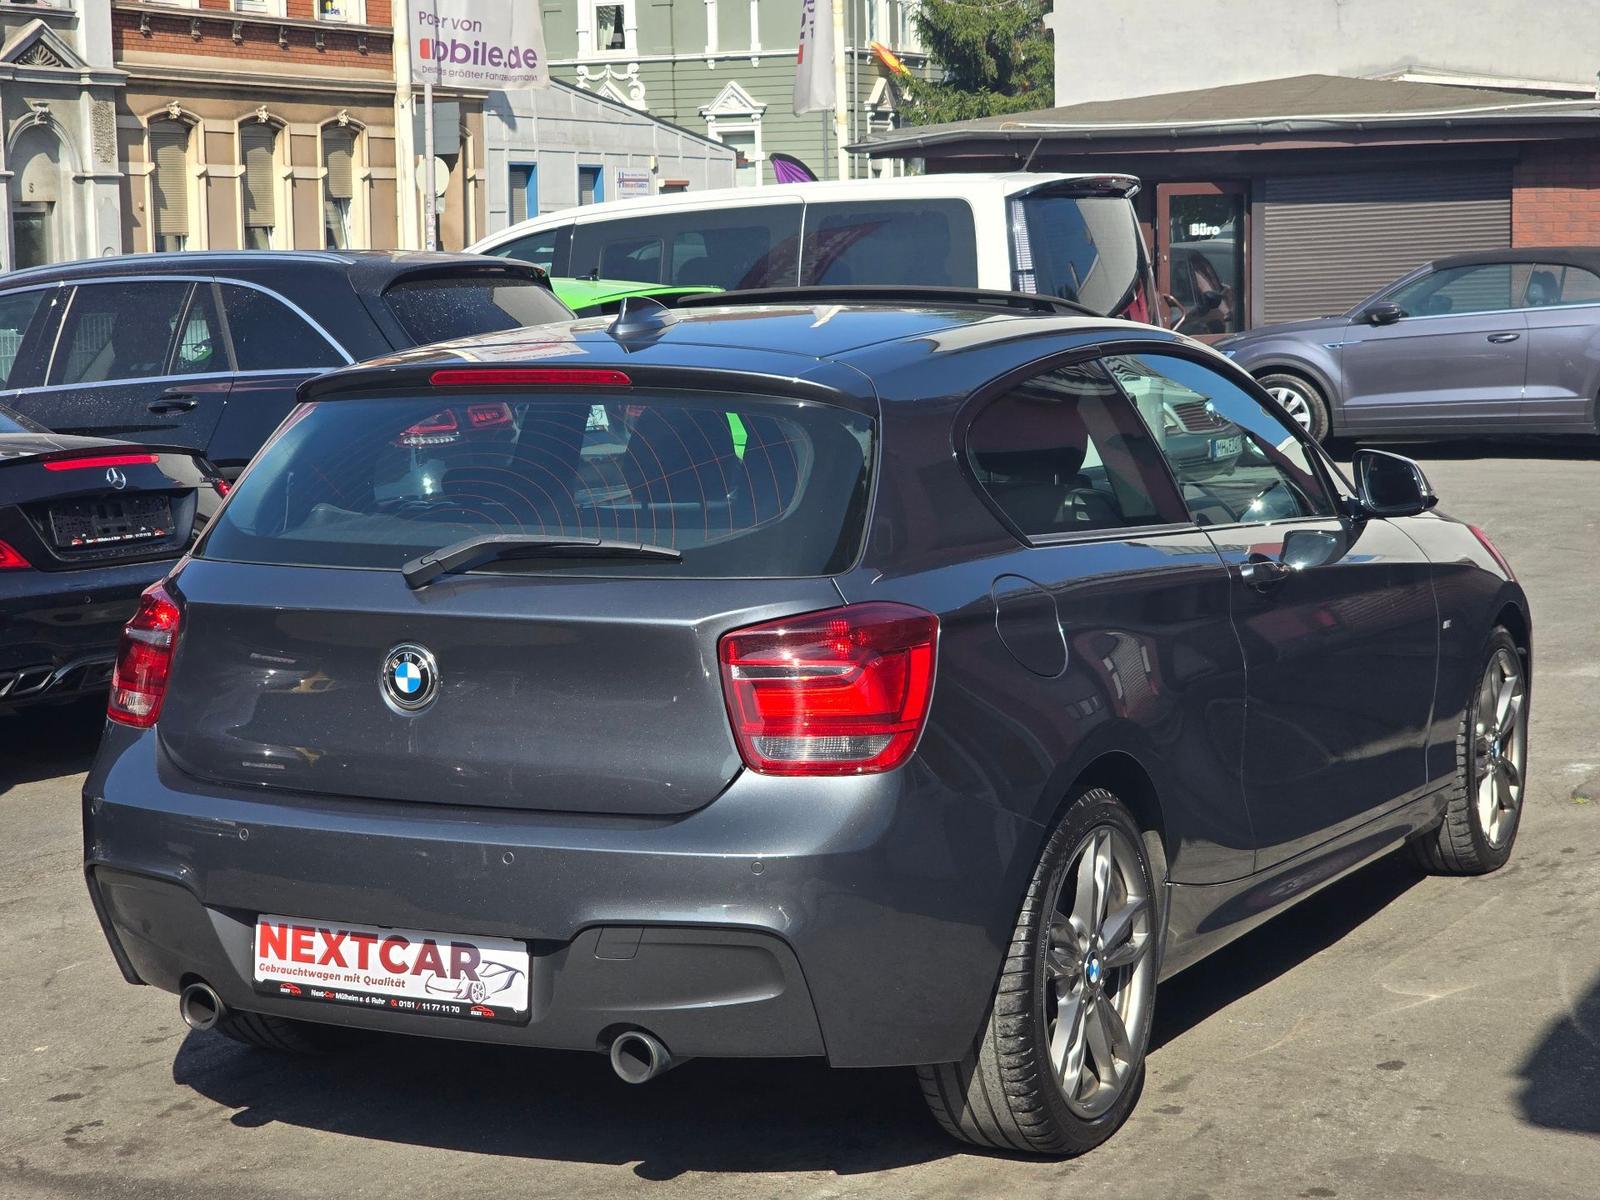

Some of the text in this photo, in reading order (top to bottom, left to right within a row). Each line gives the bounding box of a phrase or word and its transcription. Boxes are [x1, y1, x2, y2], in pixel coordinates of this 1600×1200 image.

[451, 17, 482, 33] von
[448, 68, 483, 81] größter
[1190, 222, 1220, 236] Büro
[389, 652, 428, 672] BMW
[259, 921, 481, 982] NEXTCAR
[258, 962, 406, 989] Gebrauchtwagen mit Qualität
[335, 991, 359, 1002] Mülheim
[371, 997, 386, 1005] Ruhr
[398, 1000, 415, 1009] 0151
[431, 1004, 440, 1012] 77
[441, 1004, 450, 1012] 11
[451, 1005, 460, 1013] 70
